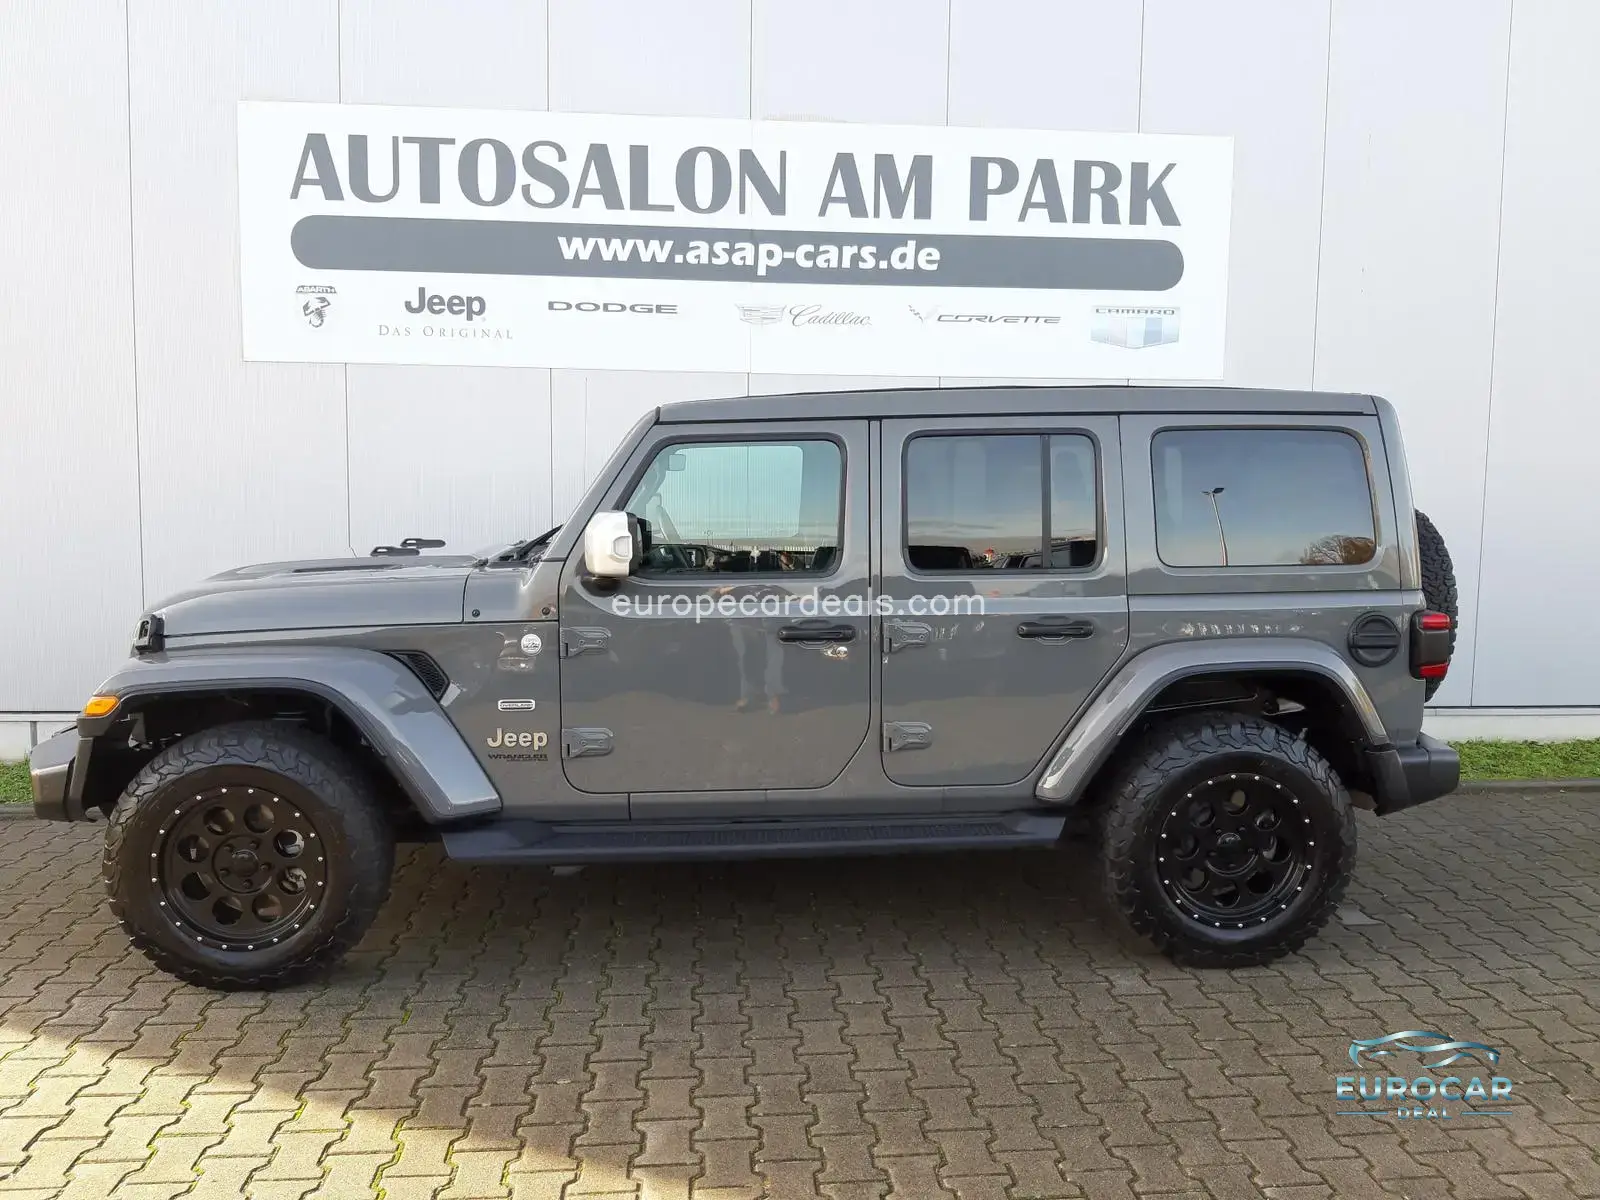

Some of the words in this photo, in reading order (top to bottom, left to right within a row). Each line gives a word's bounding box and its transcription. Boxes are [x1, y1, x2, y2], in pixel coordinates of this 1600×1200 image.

[290, 132, 787, 217] AUTOSALON
[818, 152, 933, 220] AM
[969, 156, 1182, 227] PARK
[557, 236, 941, 277] www.asap-cars.de
[404, 286, 486, 321] Jeep
[547, 300, 679, 315] DODGE
[1094, 308, 1176, 316] CAMARO
[789, 304, 873, 328] Cadillac
[936, 313, 1062, 325] CORVETTE
[486, 727, 548, 751] Jeep
